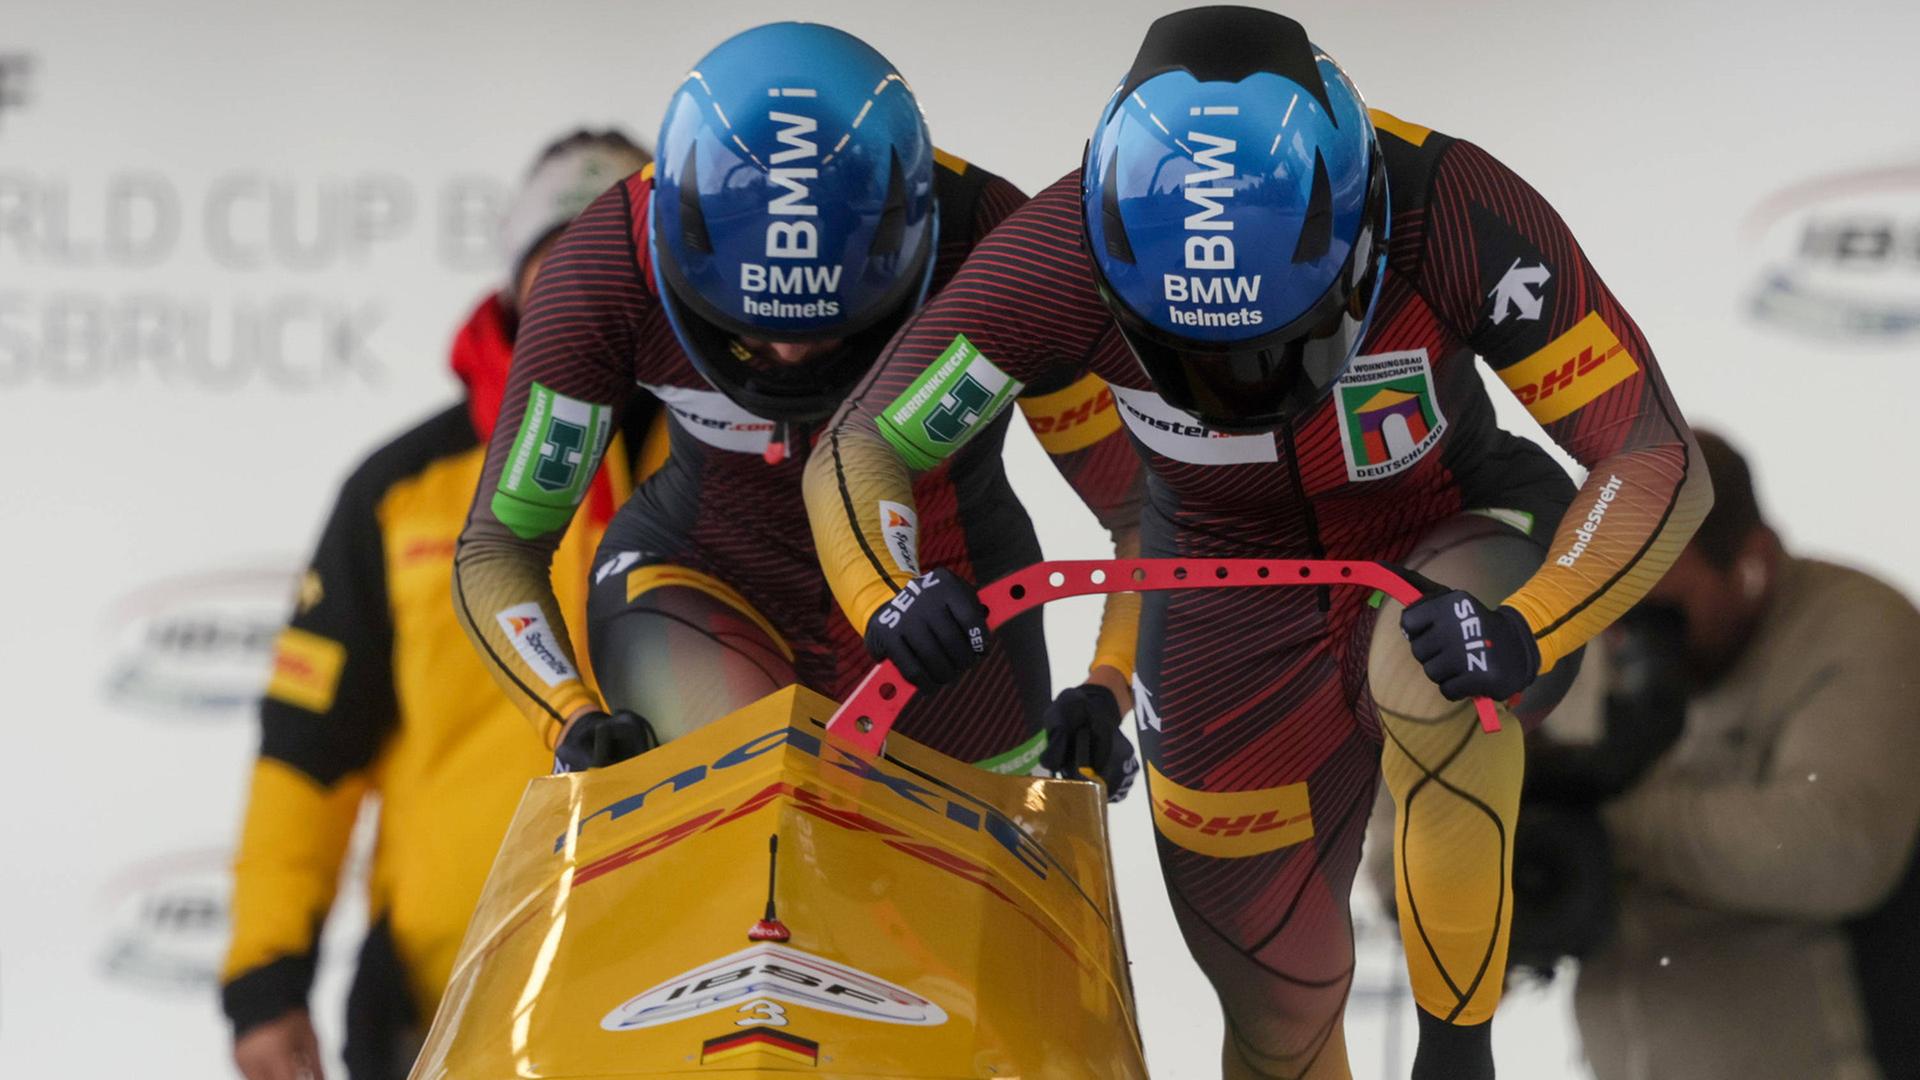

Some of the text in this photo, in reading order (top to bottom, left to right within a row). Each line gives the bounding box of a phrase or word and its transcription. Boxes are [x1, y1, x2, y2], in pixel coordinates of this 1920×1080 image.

[766, 111, 818, 259] BMW
[1184, 131, 1237, 270] BMW
[740, 263, 843, 294] BMW
[1163, 273, 1262, 304] BMW
[743, 296, 840, 318] helmets
[1169, 306, 1263, 327] helmets
[892, 342, 970, 426] HERRENKNECHT
[1354, 356, 1422, 374] WOHNUNGSBAU
[1513, 345, 1606, 406] DHL
[1356, 424, 1443, 478] DEUTSCHLAND
[1556, 474, 1623, 567] Bundeswehr
[1453, 598, 1494, 672] SEIZ
[1163, 798, 1289, 837] DHL
[666, 963, 886, 1005] IBSF
[734, 999, 790, 1027] 3
